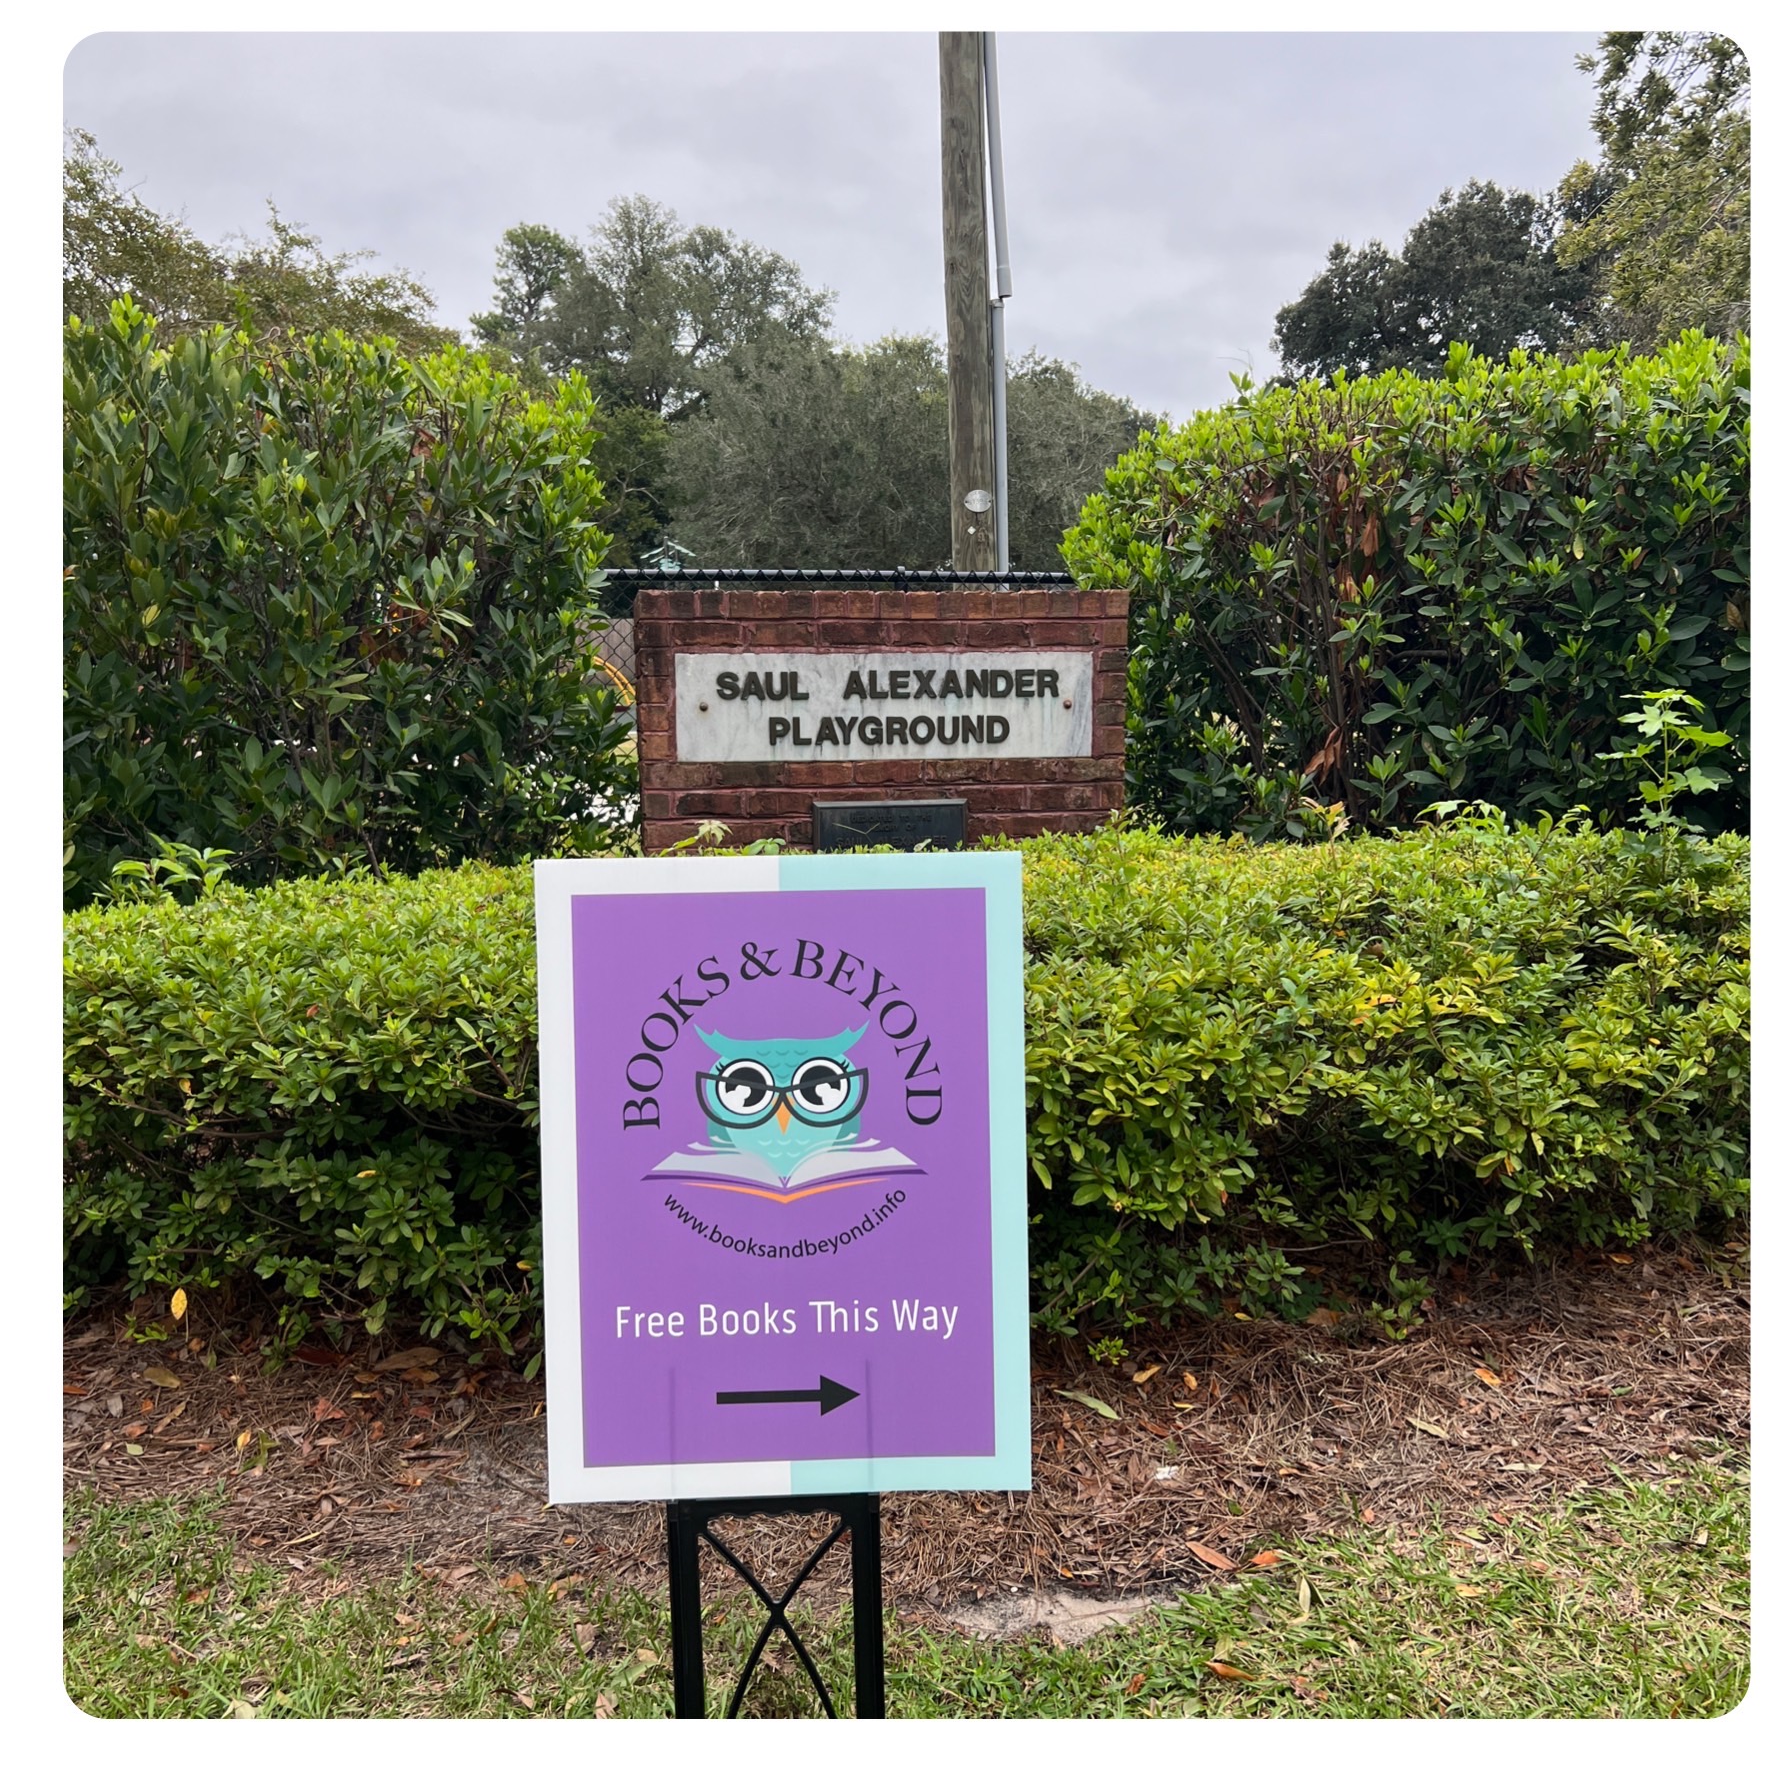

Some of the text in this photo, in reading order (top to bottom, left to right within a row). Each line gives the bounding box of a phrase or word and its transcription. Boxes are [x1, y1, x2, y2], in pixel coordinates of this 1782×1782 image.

[716, 668, 1060, 701] SAUL ALEXANDER
[768, 714, 1011, 747] PLAYGROUND
[622, 937, 944, 1130] BOOKS & BEYOND
[663, 1185, 907, 1260] www.booksandbeyond.info
[615, 1299, 959, 1341] Free Books This Way
